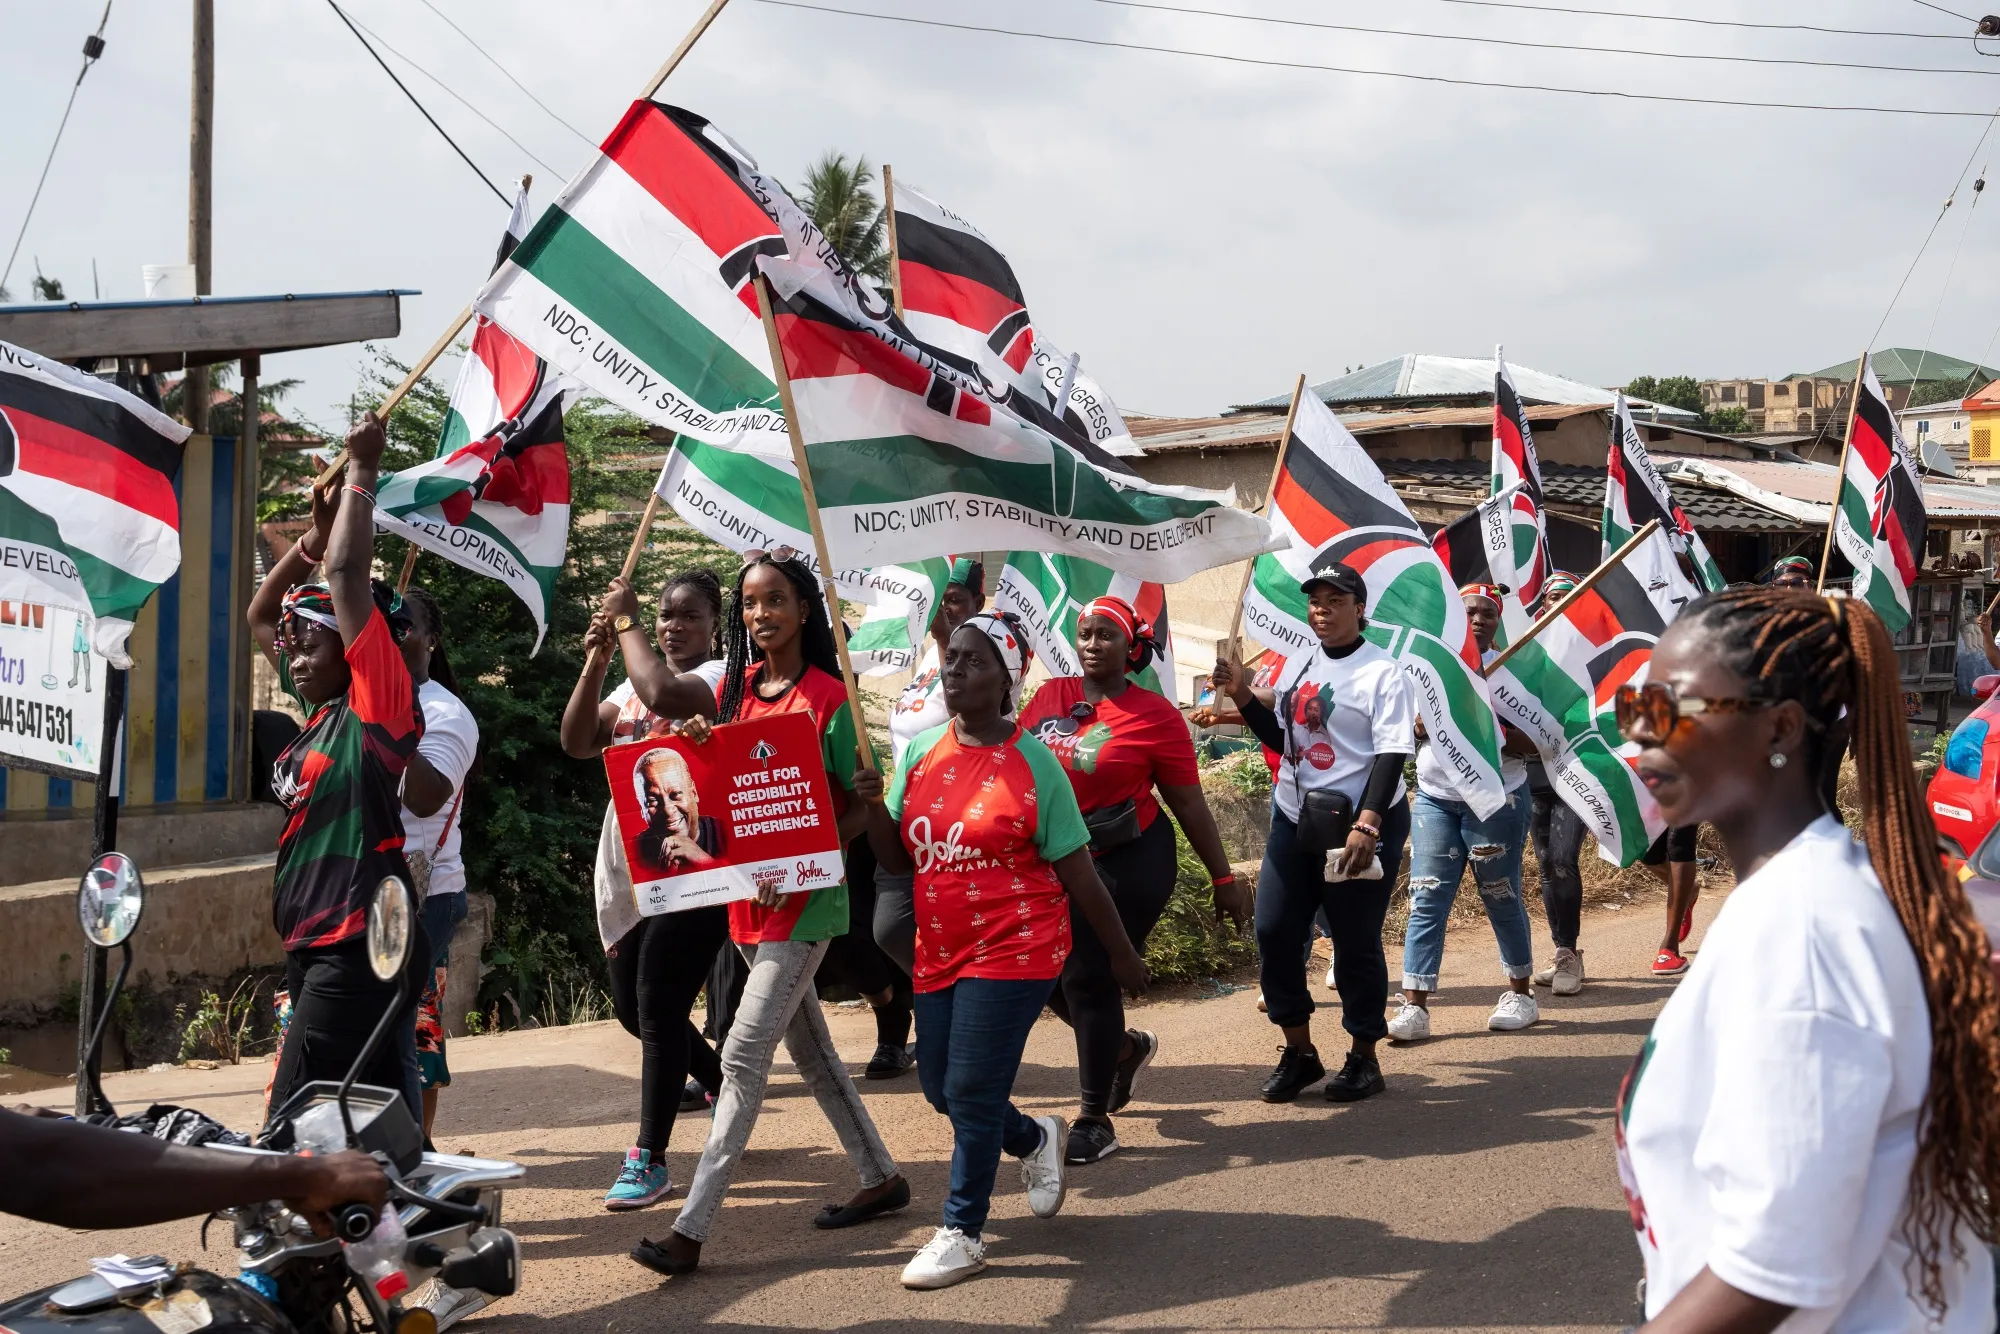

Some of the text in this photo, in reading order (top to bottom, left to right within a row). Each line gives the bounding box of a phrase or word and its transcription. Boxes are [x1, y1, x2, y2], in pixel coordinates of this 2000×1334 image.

[543, 303, 592, 353] NDC;
[592, 340, 657, 401] UNITY,
[656, 392, 742, 433] STABILITY
[737, 414, 770, 432] AND
[854, 498, 1216, 552] NDC; UNITY, STABILITY AND DEVELOENT
[400, 516, 525, 580] ELOPMENT
[0, 546, 80, 583] EVELOP
[870, 575, 907, 596] AND
[995, 578, 1071, 675] STABILITY AND
[1405, 663, 1431, 689] AND
[16, 698, 42, 739] 547
[45, 704, 73, 746] 531
[1051, 748, 1089, 761] AHAMA
[732, 766, 801, 788] VOTE FOR
[981, 780, 996, 788] NDC
[728, 781, 811, 805] CREDIBILITY
[1562, 770, 1616, 839] DEVELOPMENT
[731, 797, 817, 821] INTEGRITY &
[970, 808, 984, 816] NDC
[733, 814, 820, 838] EXPERIENCE
[908, 815, 983, 874] John
[751, 868, 788, 880] THE GHANA
[797, 860, 831, 887] John
[649, 895, 667, 905] NDC
[1017, 906, 1032, 915] NDC
[971, 918, 987, 927] NDC
